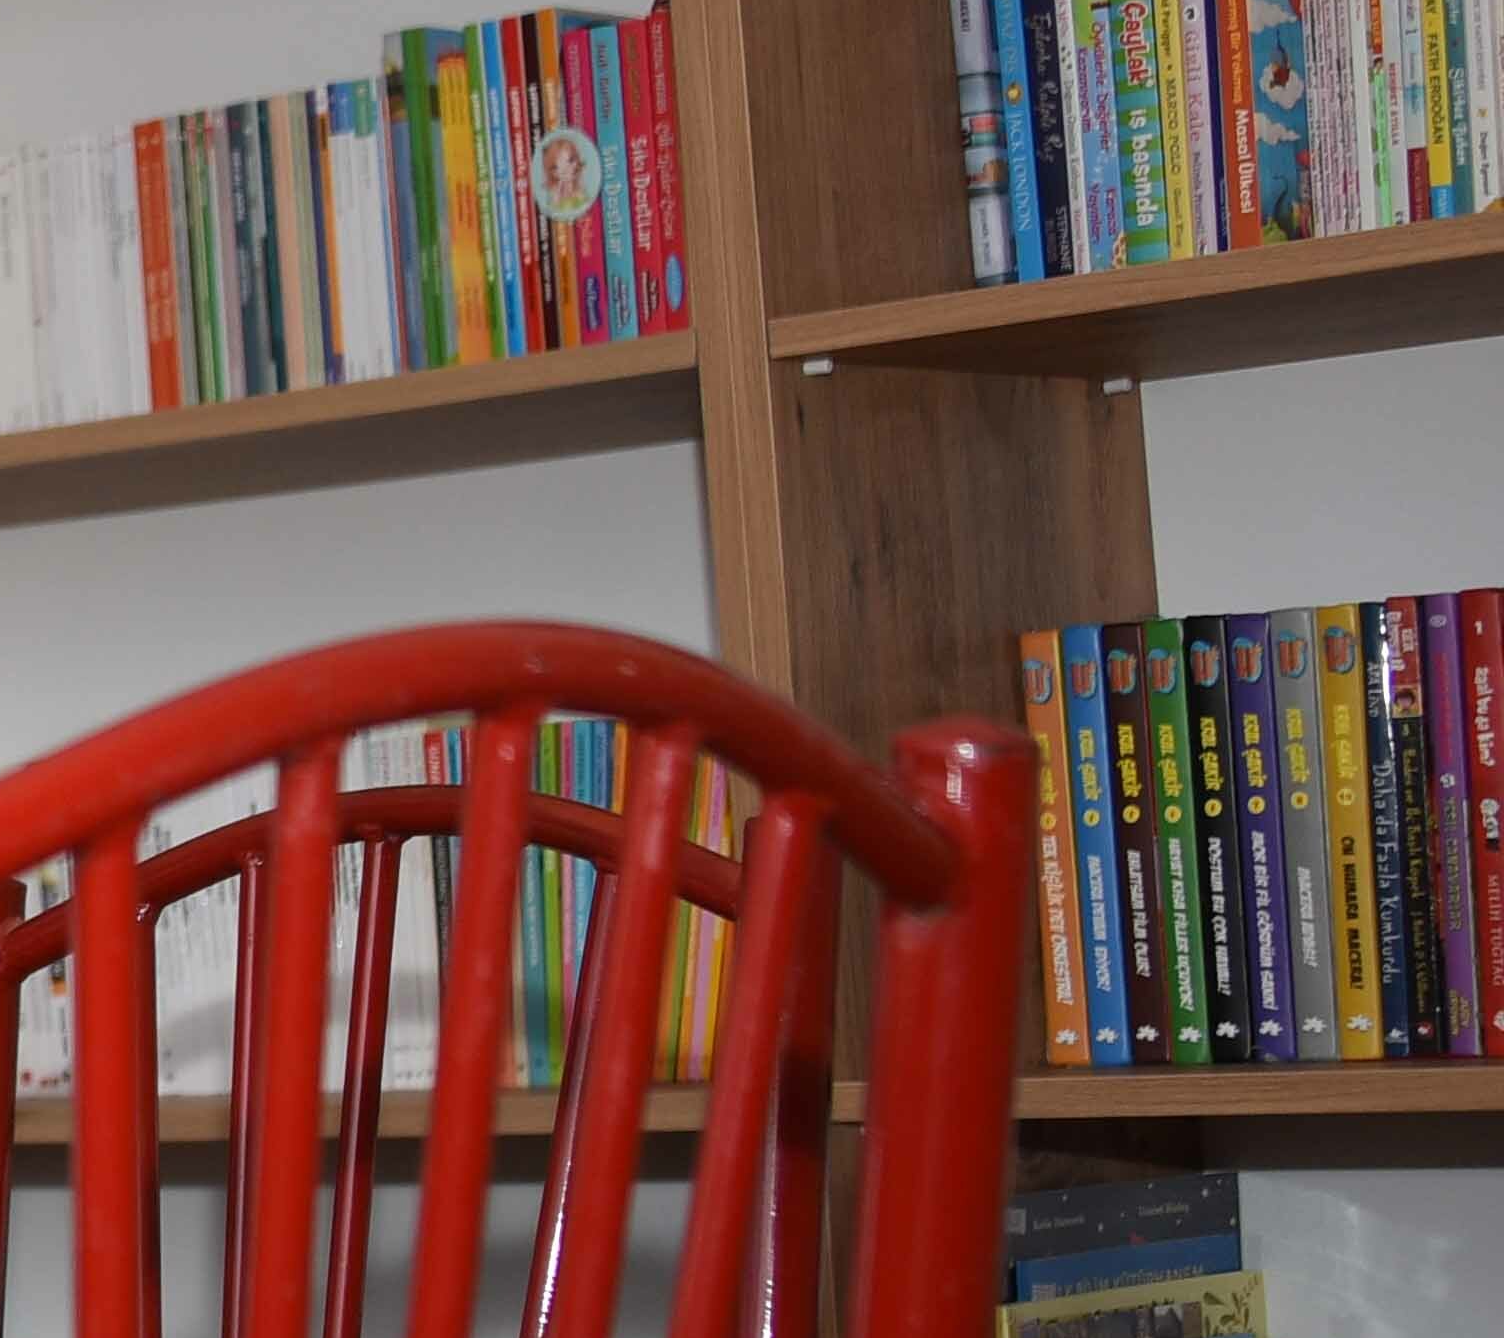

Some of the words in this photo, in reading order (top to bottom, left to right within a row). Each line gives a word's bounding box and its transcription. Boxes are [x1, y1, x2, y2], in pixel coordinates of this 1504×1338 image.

[1167, 77, 1179, 130] MARCO
[1430, 75, 1447, 145] ERDOĞAN
[1006, 112, 1026, 152] JACK
[1169, 134, 1181, 174] POLO
[1234, 109, 1251, 159] Masal
[1012, 158, 1033, 231] LONDON
[1238, 163, 1257, 213] Ülkesi
[633, 175, 652, 252] Dostlar
[1372, 761, 1396, 809] Daha
[1341, 836, 1356, 855] ON
[1374, 815, 1393, 835] da
[1376, 842, 1398, 887] Fazla
[1343, 863, 1360, 920] NUMARA
[1347, 928, 1364, 989] MACERA!
[1379, 897, 1403, 984] Kumkurdu
